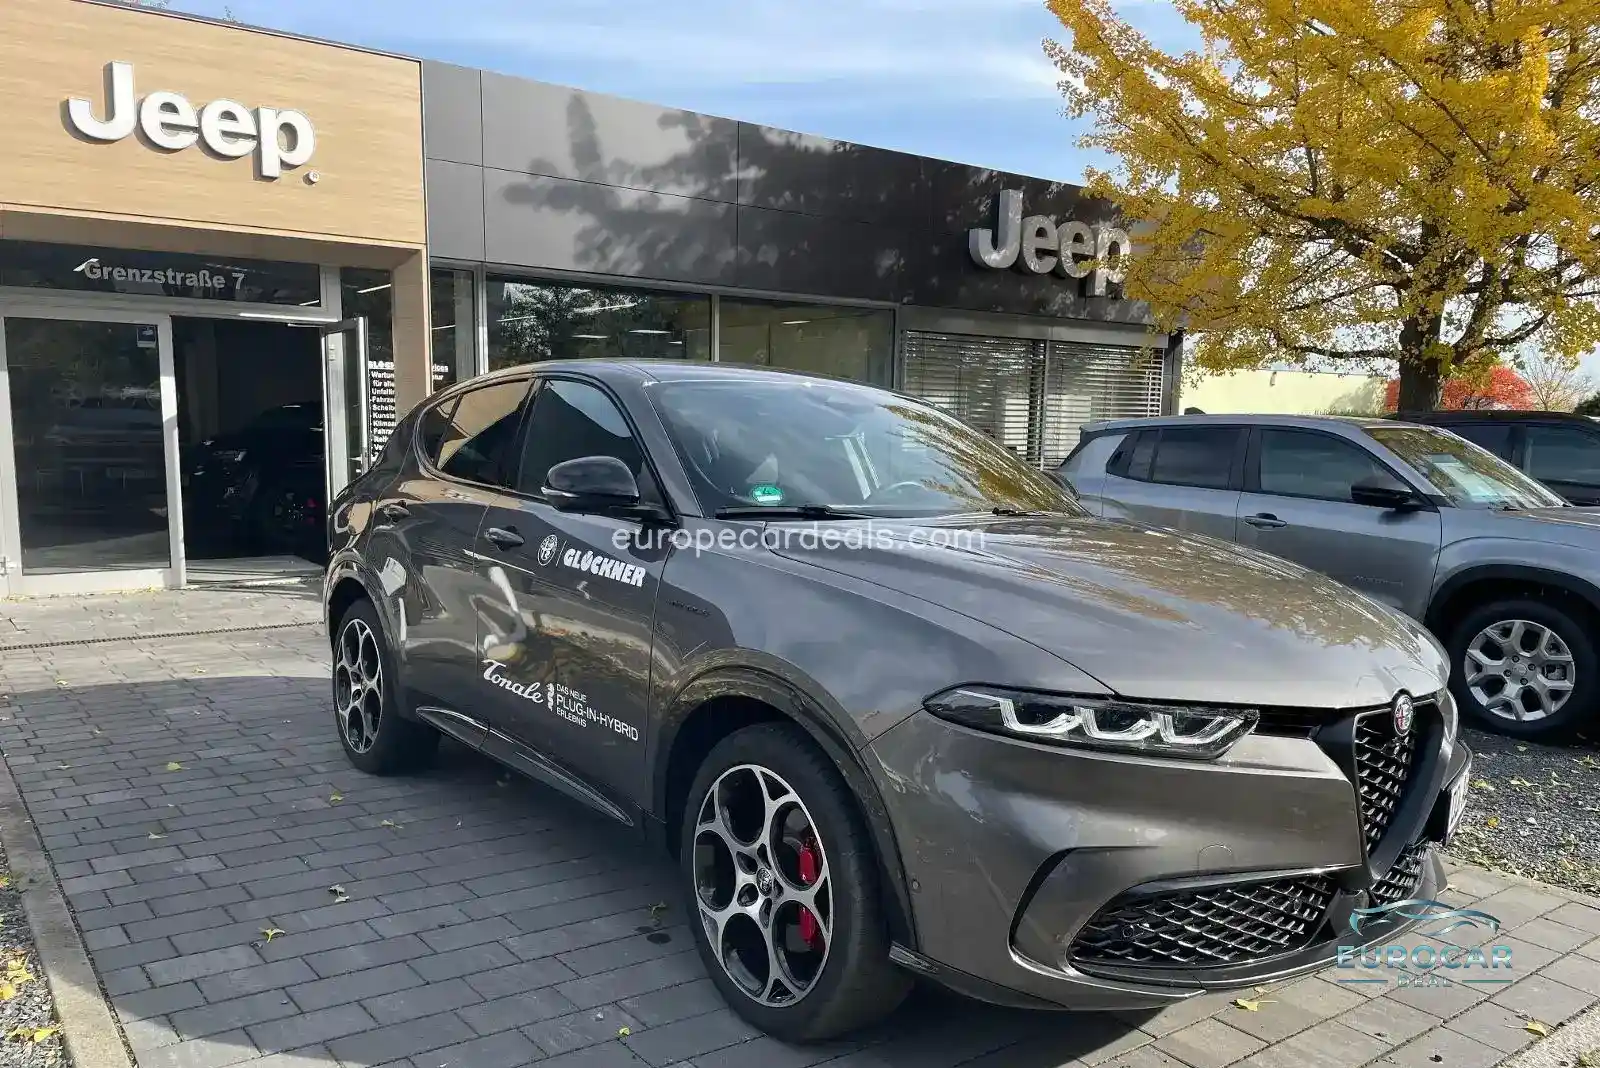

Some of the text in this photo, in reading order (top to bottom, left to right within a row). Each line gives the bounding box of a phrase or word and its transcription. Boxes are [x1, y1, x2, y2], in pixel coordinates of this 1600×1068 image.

[62, 61, 315, 180] Jeep
[969, 189, 1131, 297] Jeep
[84, 261, 245, 290] Grenzstraße 7
[563, 548, 646, 587] GLÜCKNER
[482, 658, 544, 704] Tonale
[556, 683, 587, 702] DAS NEUE
[556, 706, 587, 728] ERLEBNIS
[556, 694, 639, 742] PLUG-IN-HYBRID
